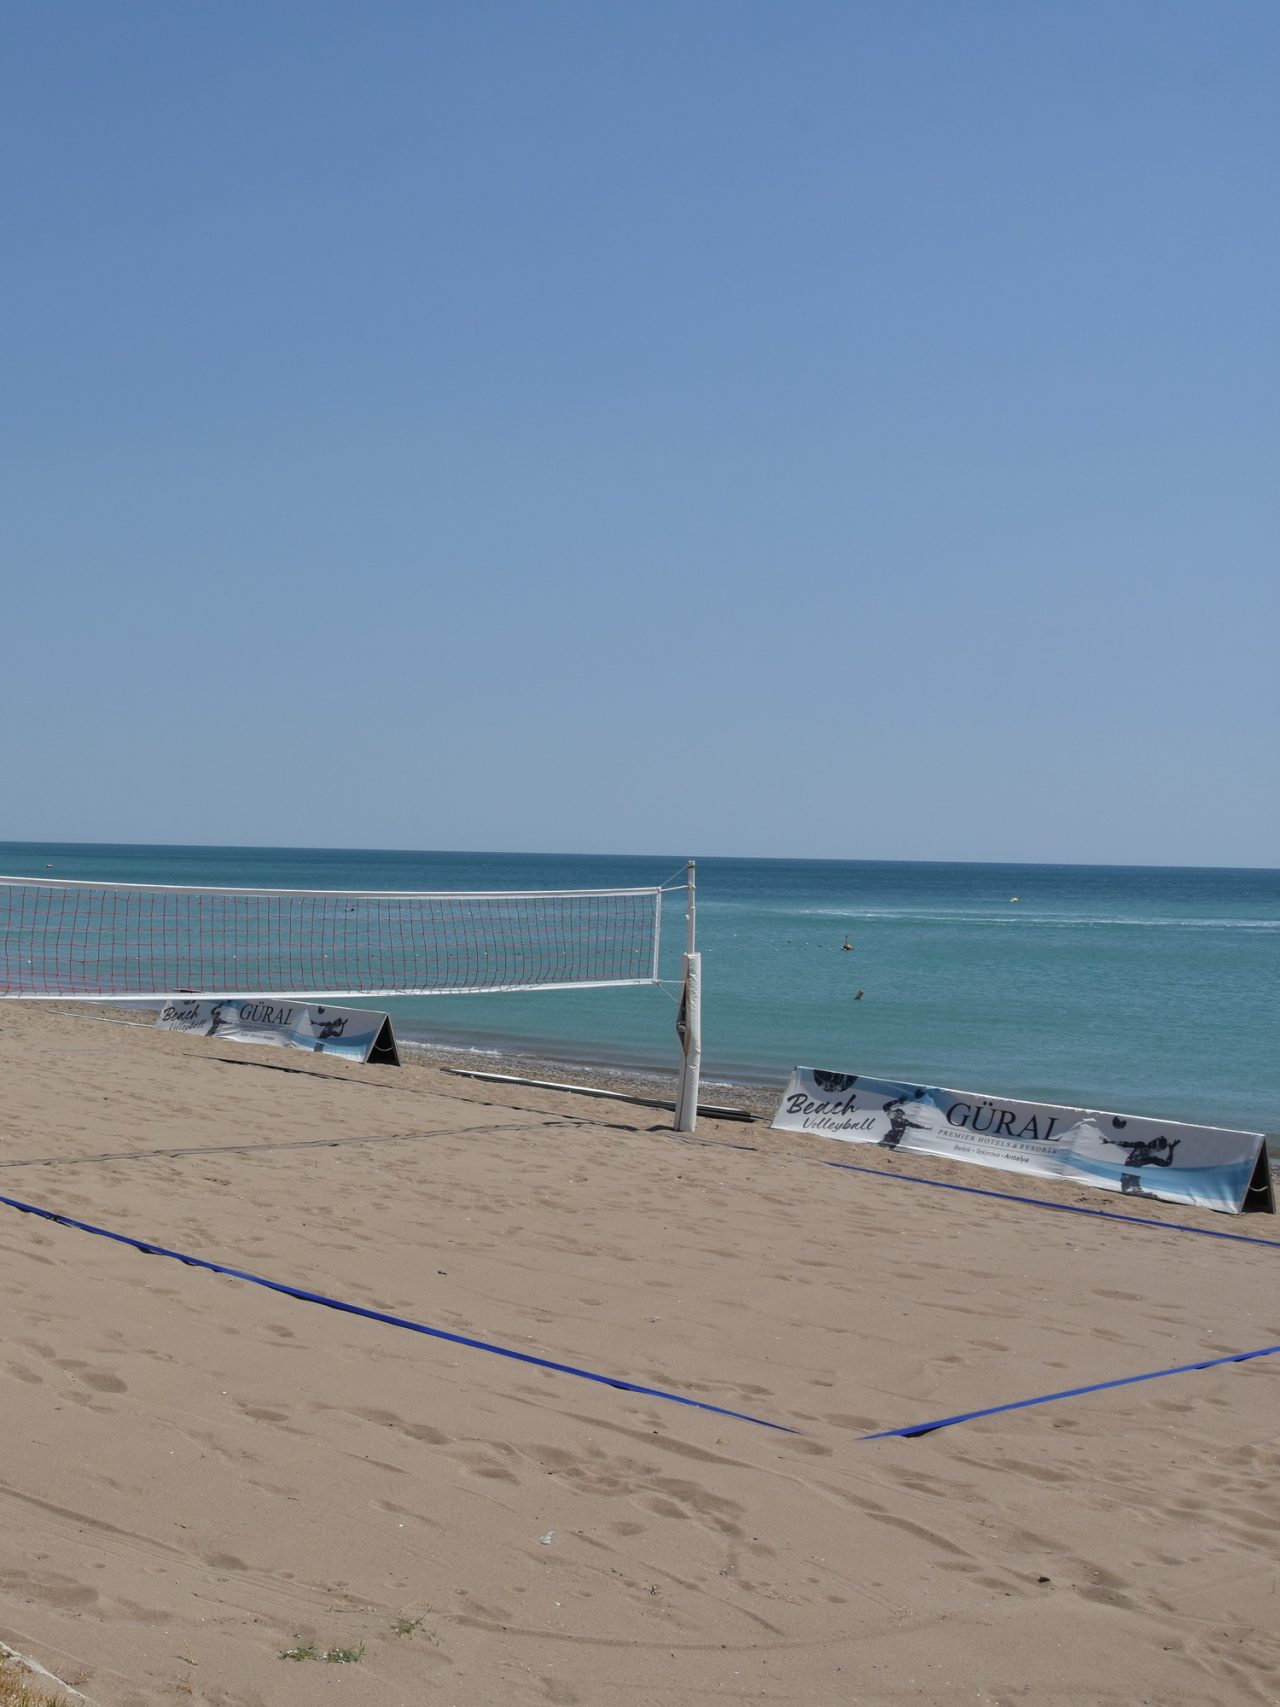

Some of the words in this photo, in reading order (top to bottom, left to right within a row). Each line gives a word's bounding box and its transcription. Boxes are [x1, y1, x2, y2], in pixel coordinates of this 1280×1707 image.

[162, 1004, 200, 1022] Beach
[240, 1001, 294, 1026] GÜRAL
[786, 1093, 858, 1116] Beach
[802, 1117, 876, 1133] Volleyball
[946, 1101, 1062, 1142] GÜRAL
[937, 1129, 976, 1142] PREMIER
[977, 1136, 1011, 1149] HOTELS
